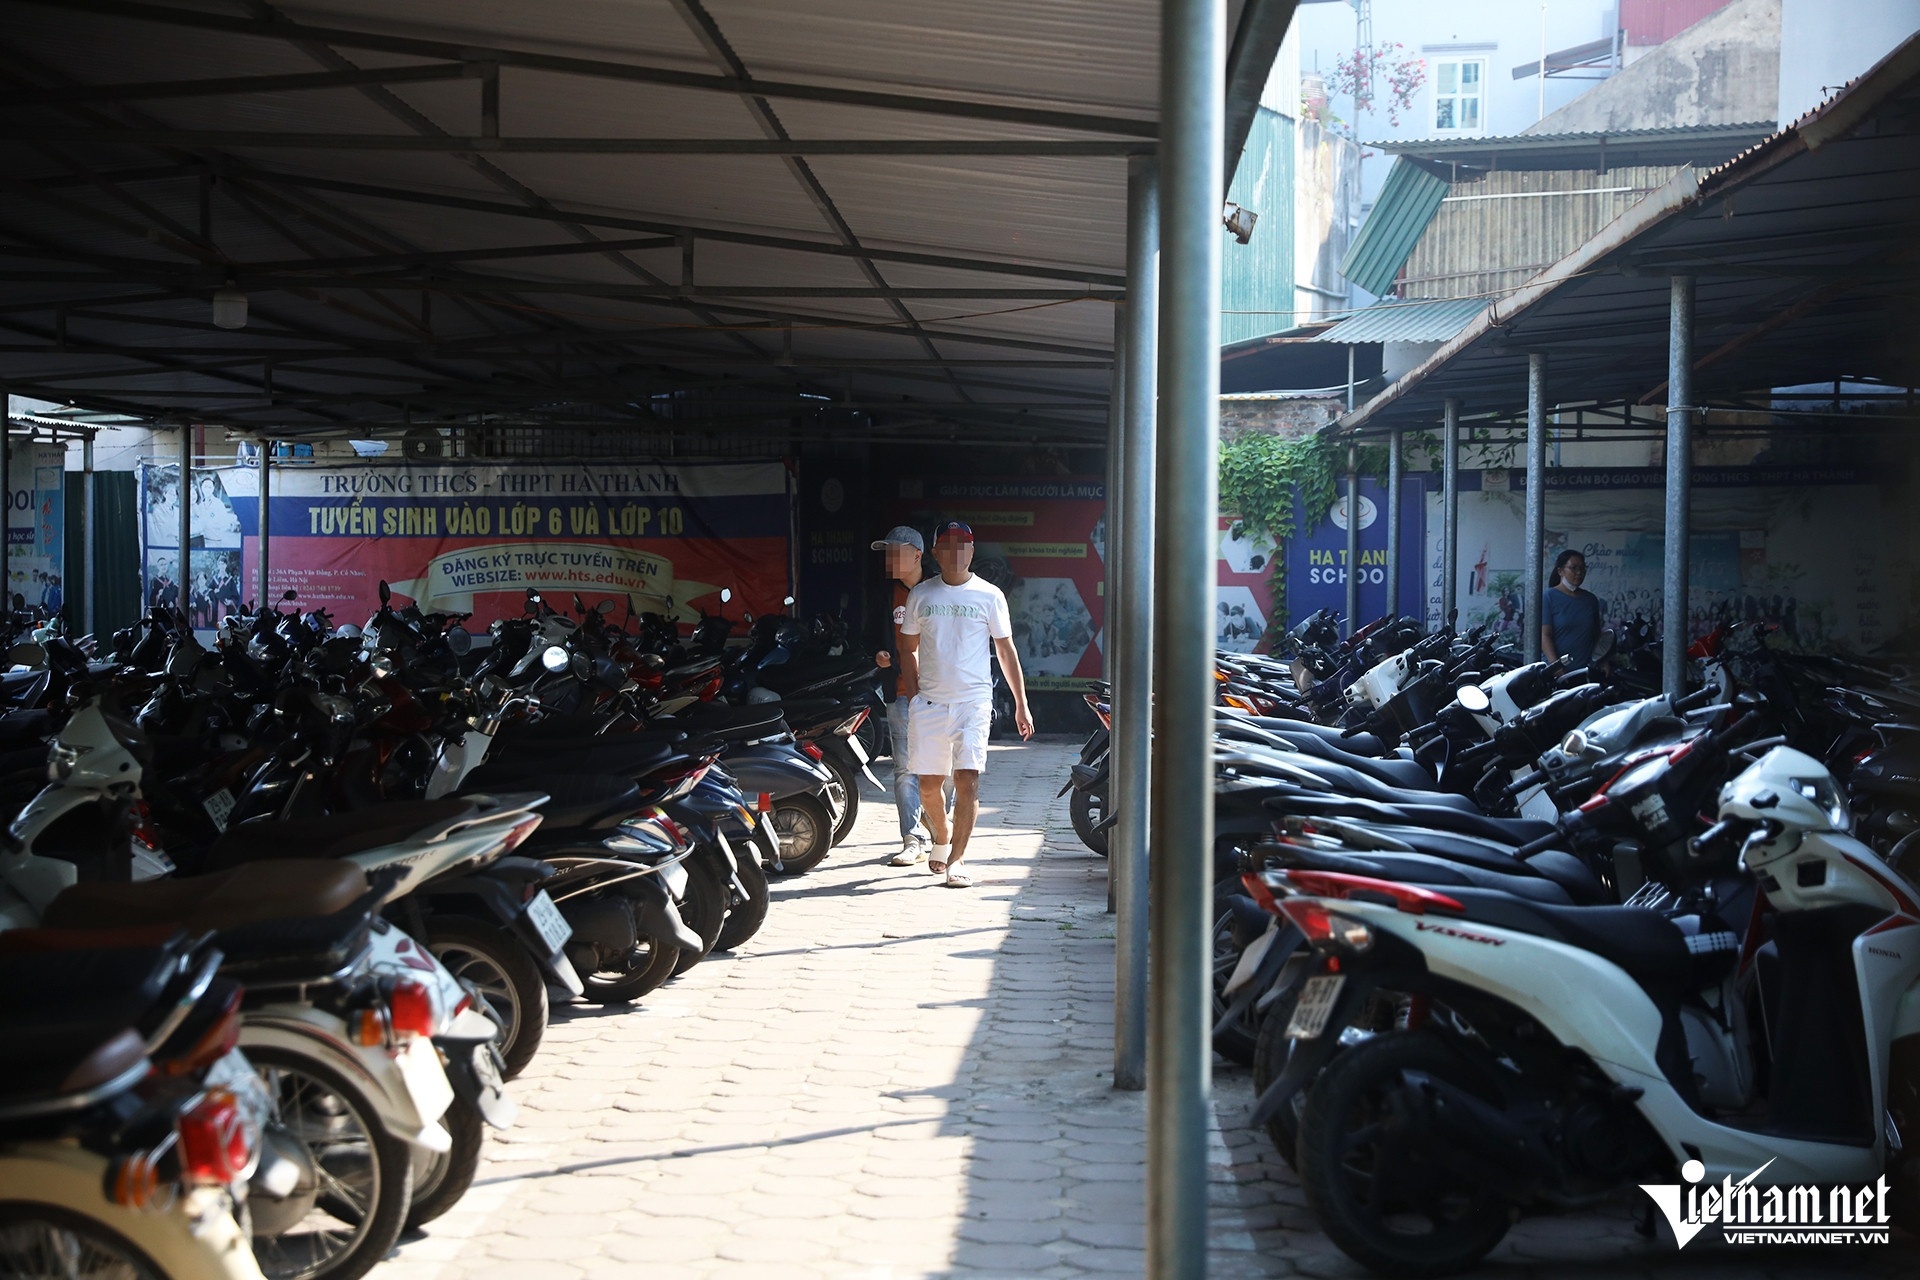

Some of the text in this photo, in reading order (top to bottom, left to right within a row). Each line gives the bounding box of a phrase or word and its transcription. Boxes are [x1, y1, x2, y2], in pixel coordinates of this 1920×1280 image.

[320, 470, 412, 492] TRƯỜNG
[418, 474, 477, 492] THCS
[497, 474, 554, 492] THPT
[562, 468, 592, 492] HÀ
[600, 468, 680, 492] THÀNH
[1021, 483, 1058, 497] NGƯỜI
[1078, 486, 1103, 500] MỤC
[309, 497, 684, 536] TUYỂN SINH VÀO LỚP 6 VÀ LỚP 10
[442, 552, 658, 576] ĐĂNG KÝ TRỰC TUYẾN TRÊN
[812, 547, 854, 564] SCHOOL
[1310, 550, 1388, 566] HA TAN
[451, 569, 646, 590] WEBSIZE: www.hts.edu.vn
[924, 604, 980, 618] BURBERRY
[1868, 946, 1902, 960] HONDA
